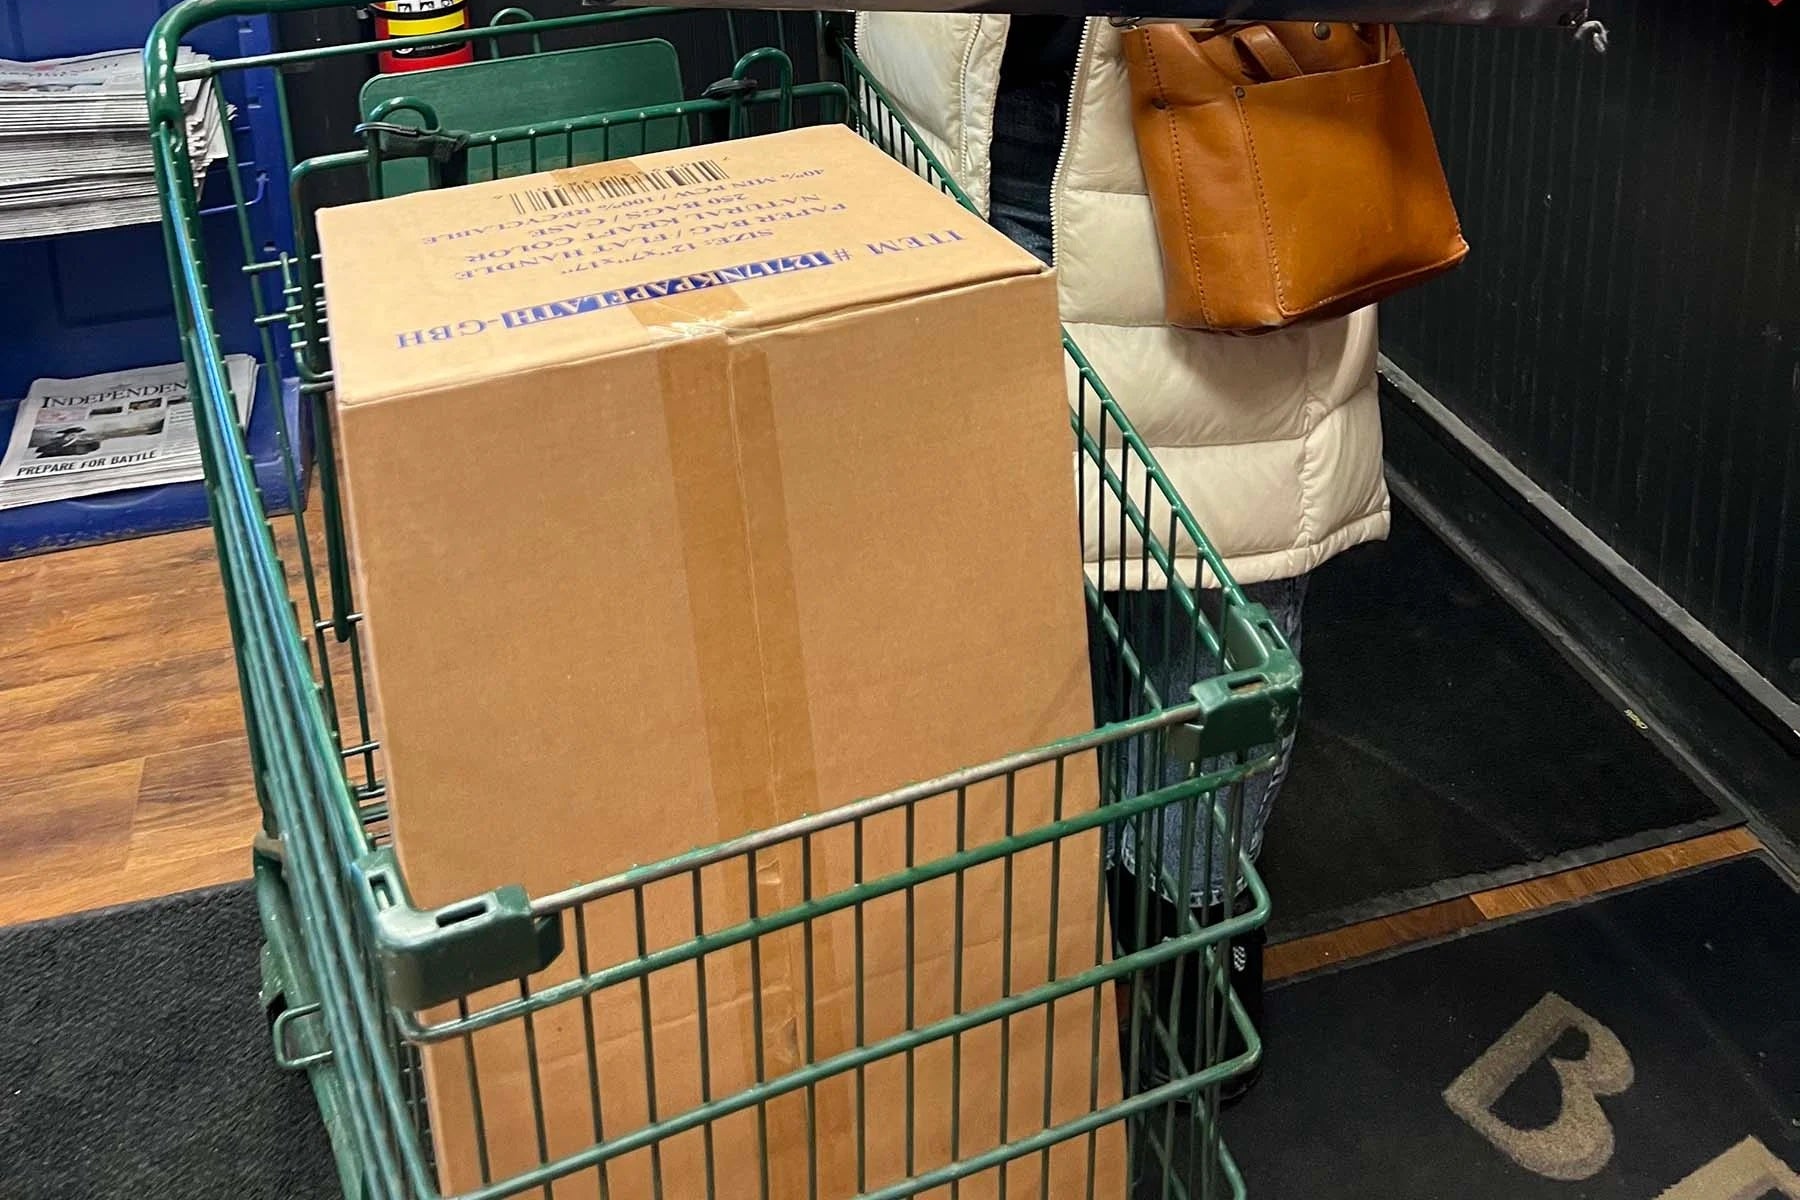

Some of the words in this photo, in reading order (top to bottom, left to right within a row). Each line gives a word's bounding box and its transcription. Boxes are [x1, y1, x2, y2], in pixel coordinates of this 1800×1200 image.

[731, 175, 777, 189] MIN
[781, 168, 825, 180] 40%
[674, 184, 725, 199] PCW
[708, 192, 748, 204] 250
[598, 197, 653, 211] 100%
[625, 201, 700, 220] BAGS
[685, 194, 820, 220] NATURAL
[758, 203, 848, 225] PAPER
[422, 208, 592, 245] RECYCLABLE
[529, 218, 606, 238] CASE
[583, 217, 678, 241] KRAFT
[690, 219, 750, 236] BAG
[705, 229, 774, 245] SIZE:
[465, 237, 574, 263] COLOR
[592, 233, 668, 256] FLAT
[867, 230, 966, 255] ITEM
[455, 248, 584, 280] HANDLE
[42, 383, 188, 408] INDEPENDEN
[17, 461, 76, 476] PREPARE
[79, 457, 106, 469] FOR
[111, 450, 157, 465] BATTLE
